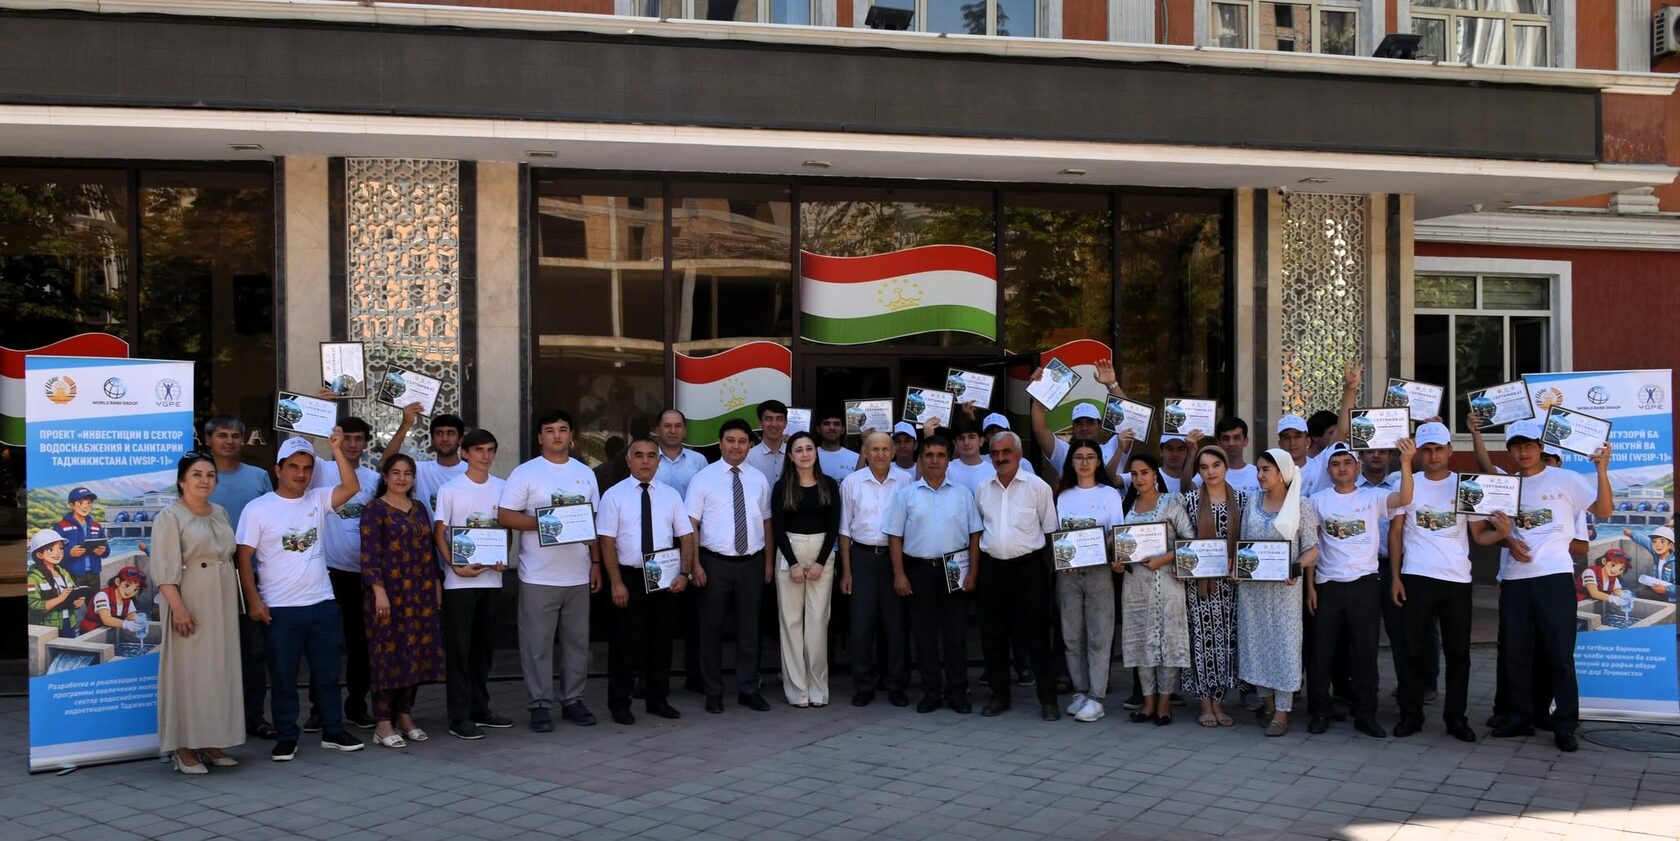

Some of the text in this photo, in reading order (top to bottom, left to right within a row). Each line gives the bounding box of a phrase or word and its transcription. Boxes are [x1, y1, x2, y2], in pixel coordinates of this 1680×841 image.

[40, 430, 75, 440] ПРОЕКТ
[77, 430, 141, 441] «ИНВЕСТИЦИИ
[143, 430, 150, 440] В
[151, 430, 183, 440] СЕКТОР
[1647, 431, 1659, 439] БА
[40, 443, 183, 454] ВОДОСНАБЖЕНИЯ И САНИТАРИИ
[1644, 441, 1656, 450] ВА
[52, 456, 128, 467] ТАДЖИКИСТАНА
[48, 681, 89, 690] Разработка
[96, 677, 137, 686] реализация
[53, 689, 94, 699] программы
[95, 686, 137, 695] вовлечения
[74, 697, 98, 706] сектор
[99, 692, 153, 703] водоснабжения
[64, 705, 119, 715] водоотведения
